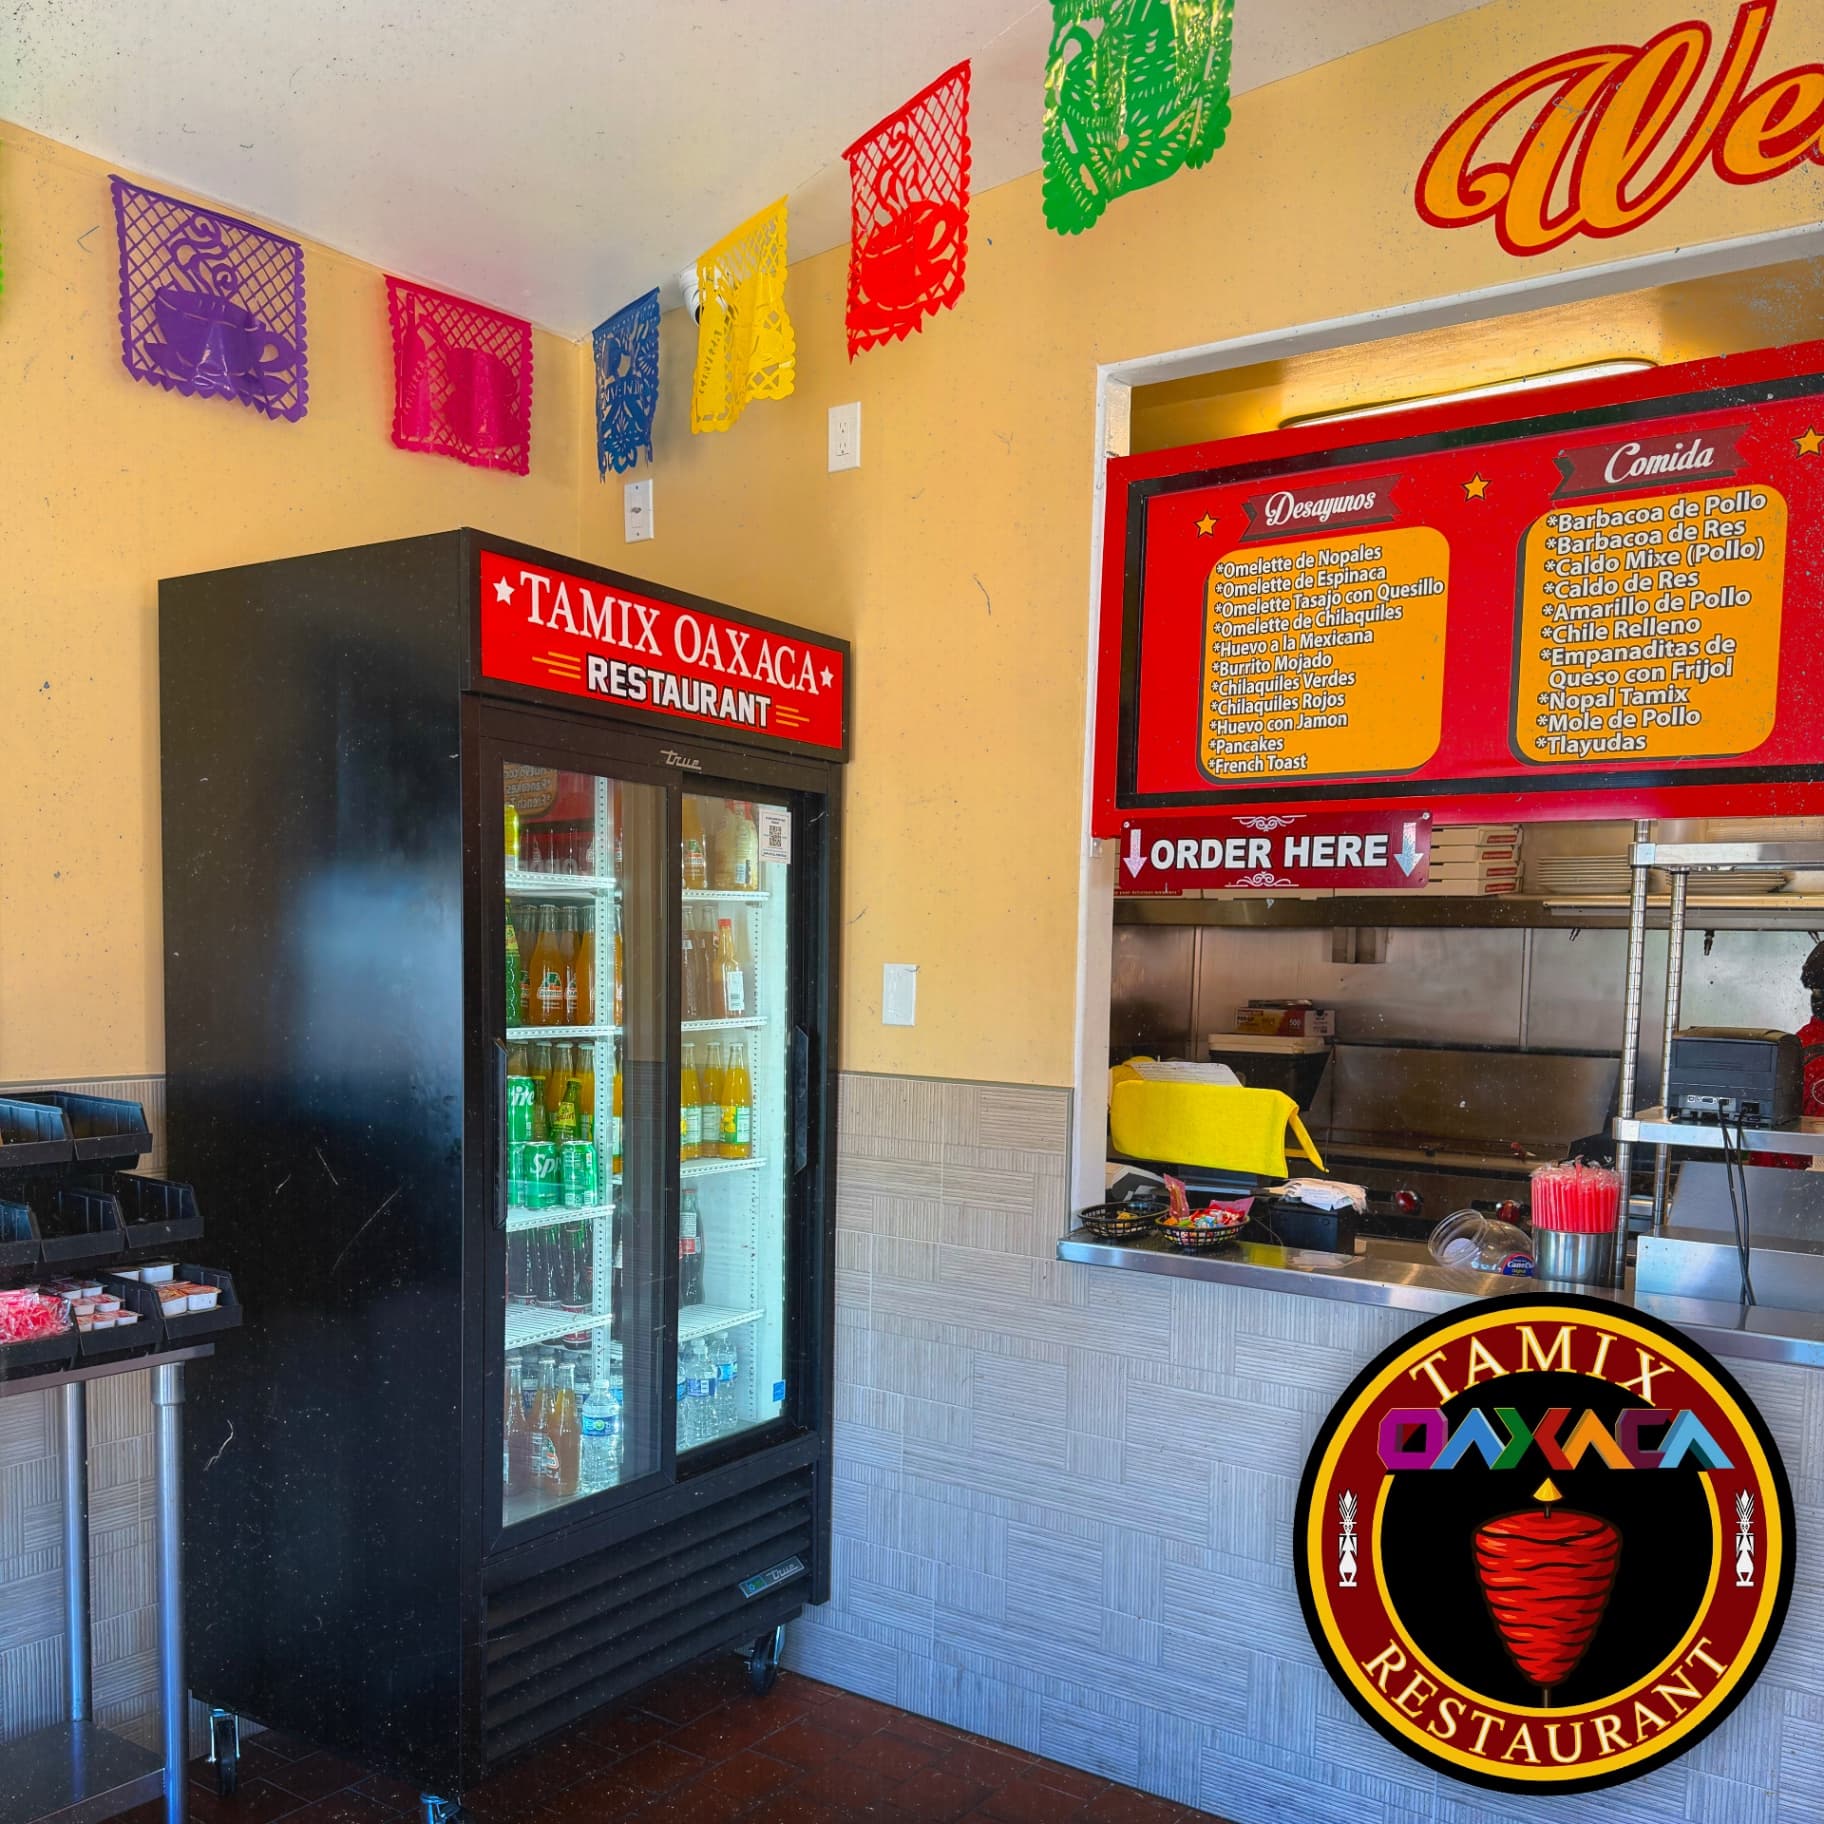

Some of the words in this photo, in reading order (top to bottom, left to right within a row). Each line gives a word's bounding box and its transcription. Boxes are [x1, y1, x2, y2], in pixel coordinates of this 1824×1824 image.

[1414, 0, 1824, 257] We
[1604, 438, 1714, 484] Comida
[1265, 491, 1376, 526] Desayunos
[1668, 499, 1700, 519] de
[1705, 491, 1767, 515] Pollo
[1668, 523, 1698, 543] de
[1703, 519, 1746, 539] Res
[1295, 555, 1315, 570] de
[1318, 544, 1382, 568] Nopales
[1625, 549, 1681, 571] Mixe
[1687, 538, 1764, 566] (Pollo)
[1294, 575, 1313, 589] de
[1318, 566, 1386, 587] Espinaca
[1623, 574, 1653, 593] de
[1658, 570, 1700, 590] Res
[1294, 592, 1341, 611] Tasajo
[1346, 588, 1373, 604] con
[1377, 577, 1444, 601] Quesillo
[1655, 593, 1685, 613] de
[1690, 587, 1752, 610] Pollo
[1293, 614, 1312, 629] de
[1315, 605, 1402, 628] Chilaquiles
[1614, 615, 1701, 638] Relleno
[520, 570, 663, 656] TAMIX
[674, 614, 819, 695] OAXACA
[1270, 640, 1279, 653] a
[1283, 635, 1296, 651] la
[1300, 628, 1374, 650] Mexicana
[1704, 634, 1736, 654] de
[1274, 652, 1332, 674] Mojado
[1549, 669, 1620, 691] Queso
[1624, 665, 1665, 682] con
[1671, 656, 1733, 685] Frijol
[586, 654, 771, 728] RESTAURANT
[1302, 670, 1355, 688] Verdes
[1302, 692, 1345, 710] Rojos
[1620, 684, 1690, 706] Tamix
[1267, 717, 1293, 732] con
[1296, 713, 1347, 731] Jamon
[1607, 709, 1637, 729] de
[1642, 706, 1701, 727] Pollo
[1267, 754, 1307, 770] Toast
[1150, 837, 1272, 870] ORDER
[1284, 833, 1389, 868] HERE
